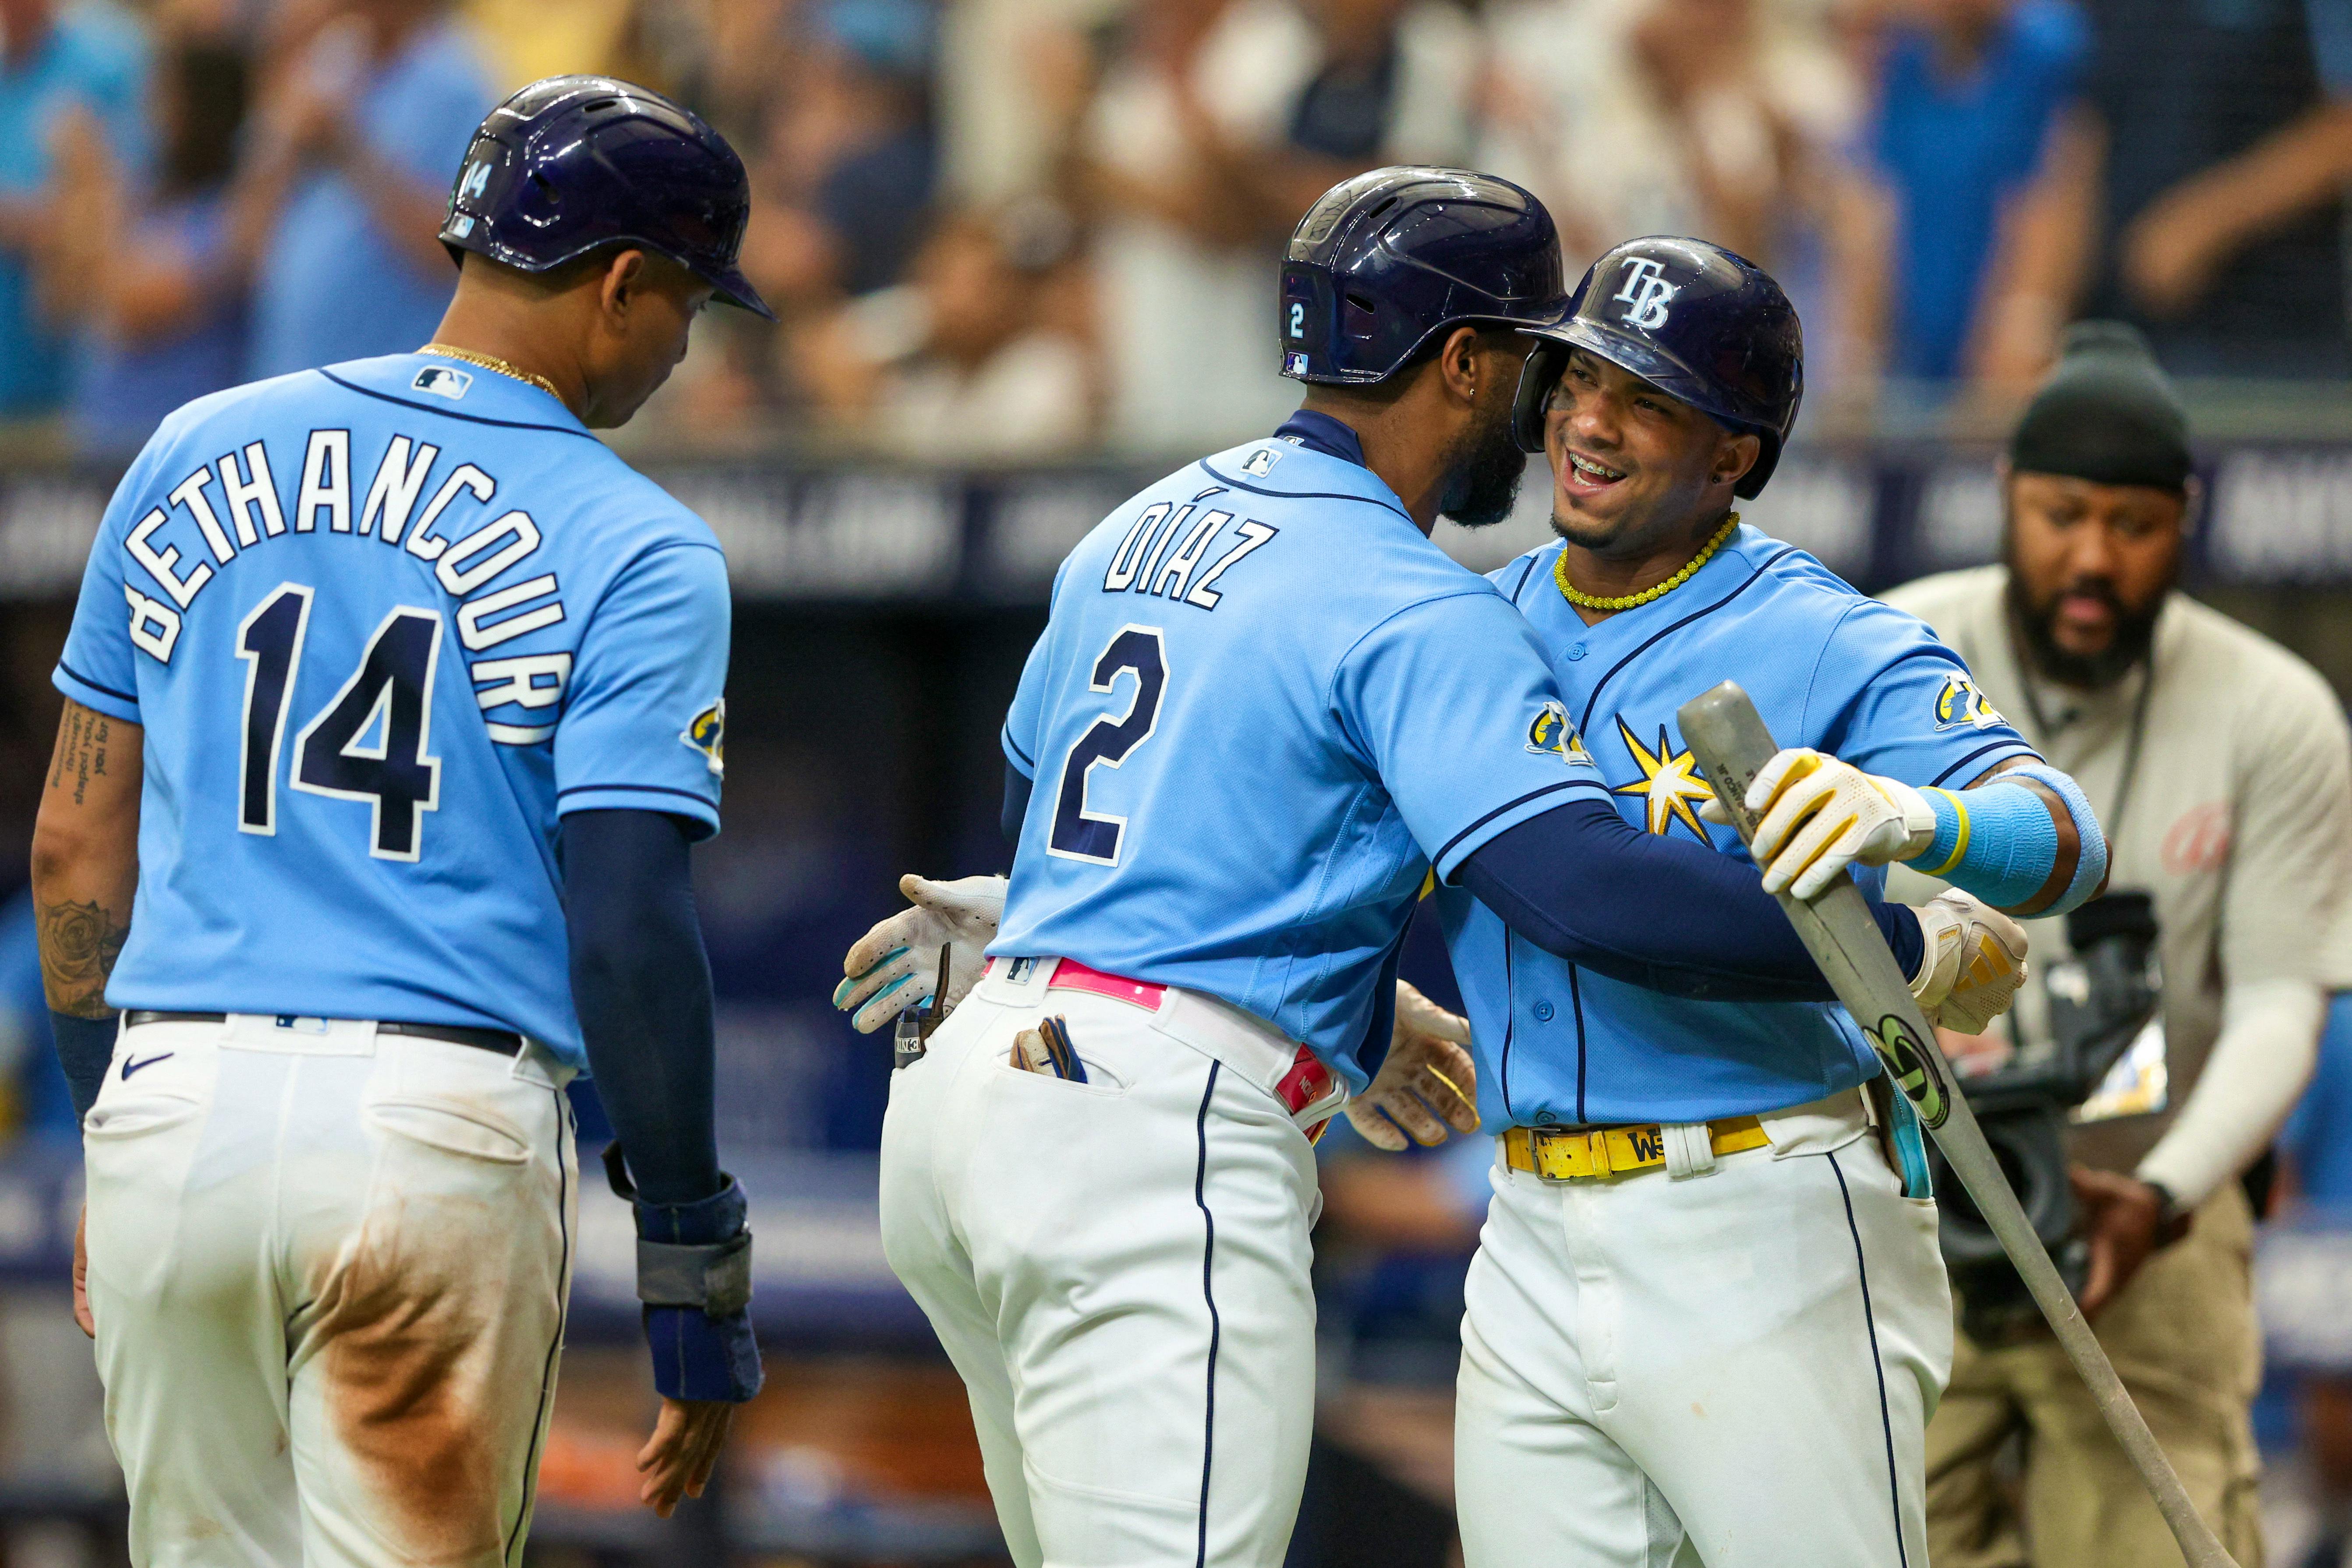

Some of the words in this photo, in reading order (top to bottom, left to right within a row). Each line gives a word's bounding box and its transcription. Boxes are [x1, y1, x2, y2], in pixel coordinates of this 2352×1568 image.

[464, 160, 492, 198] 14
[1291, 303, 1304, 339] 2
[1613, 256, 1675, 330] TB
[235, 581, 444, 863] 14
[1047, 623, 1171, 867] 2
